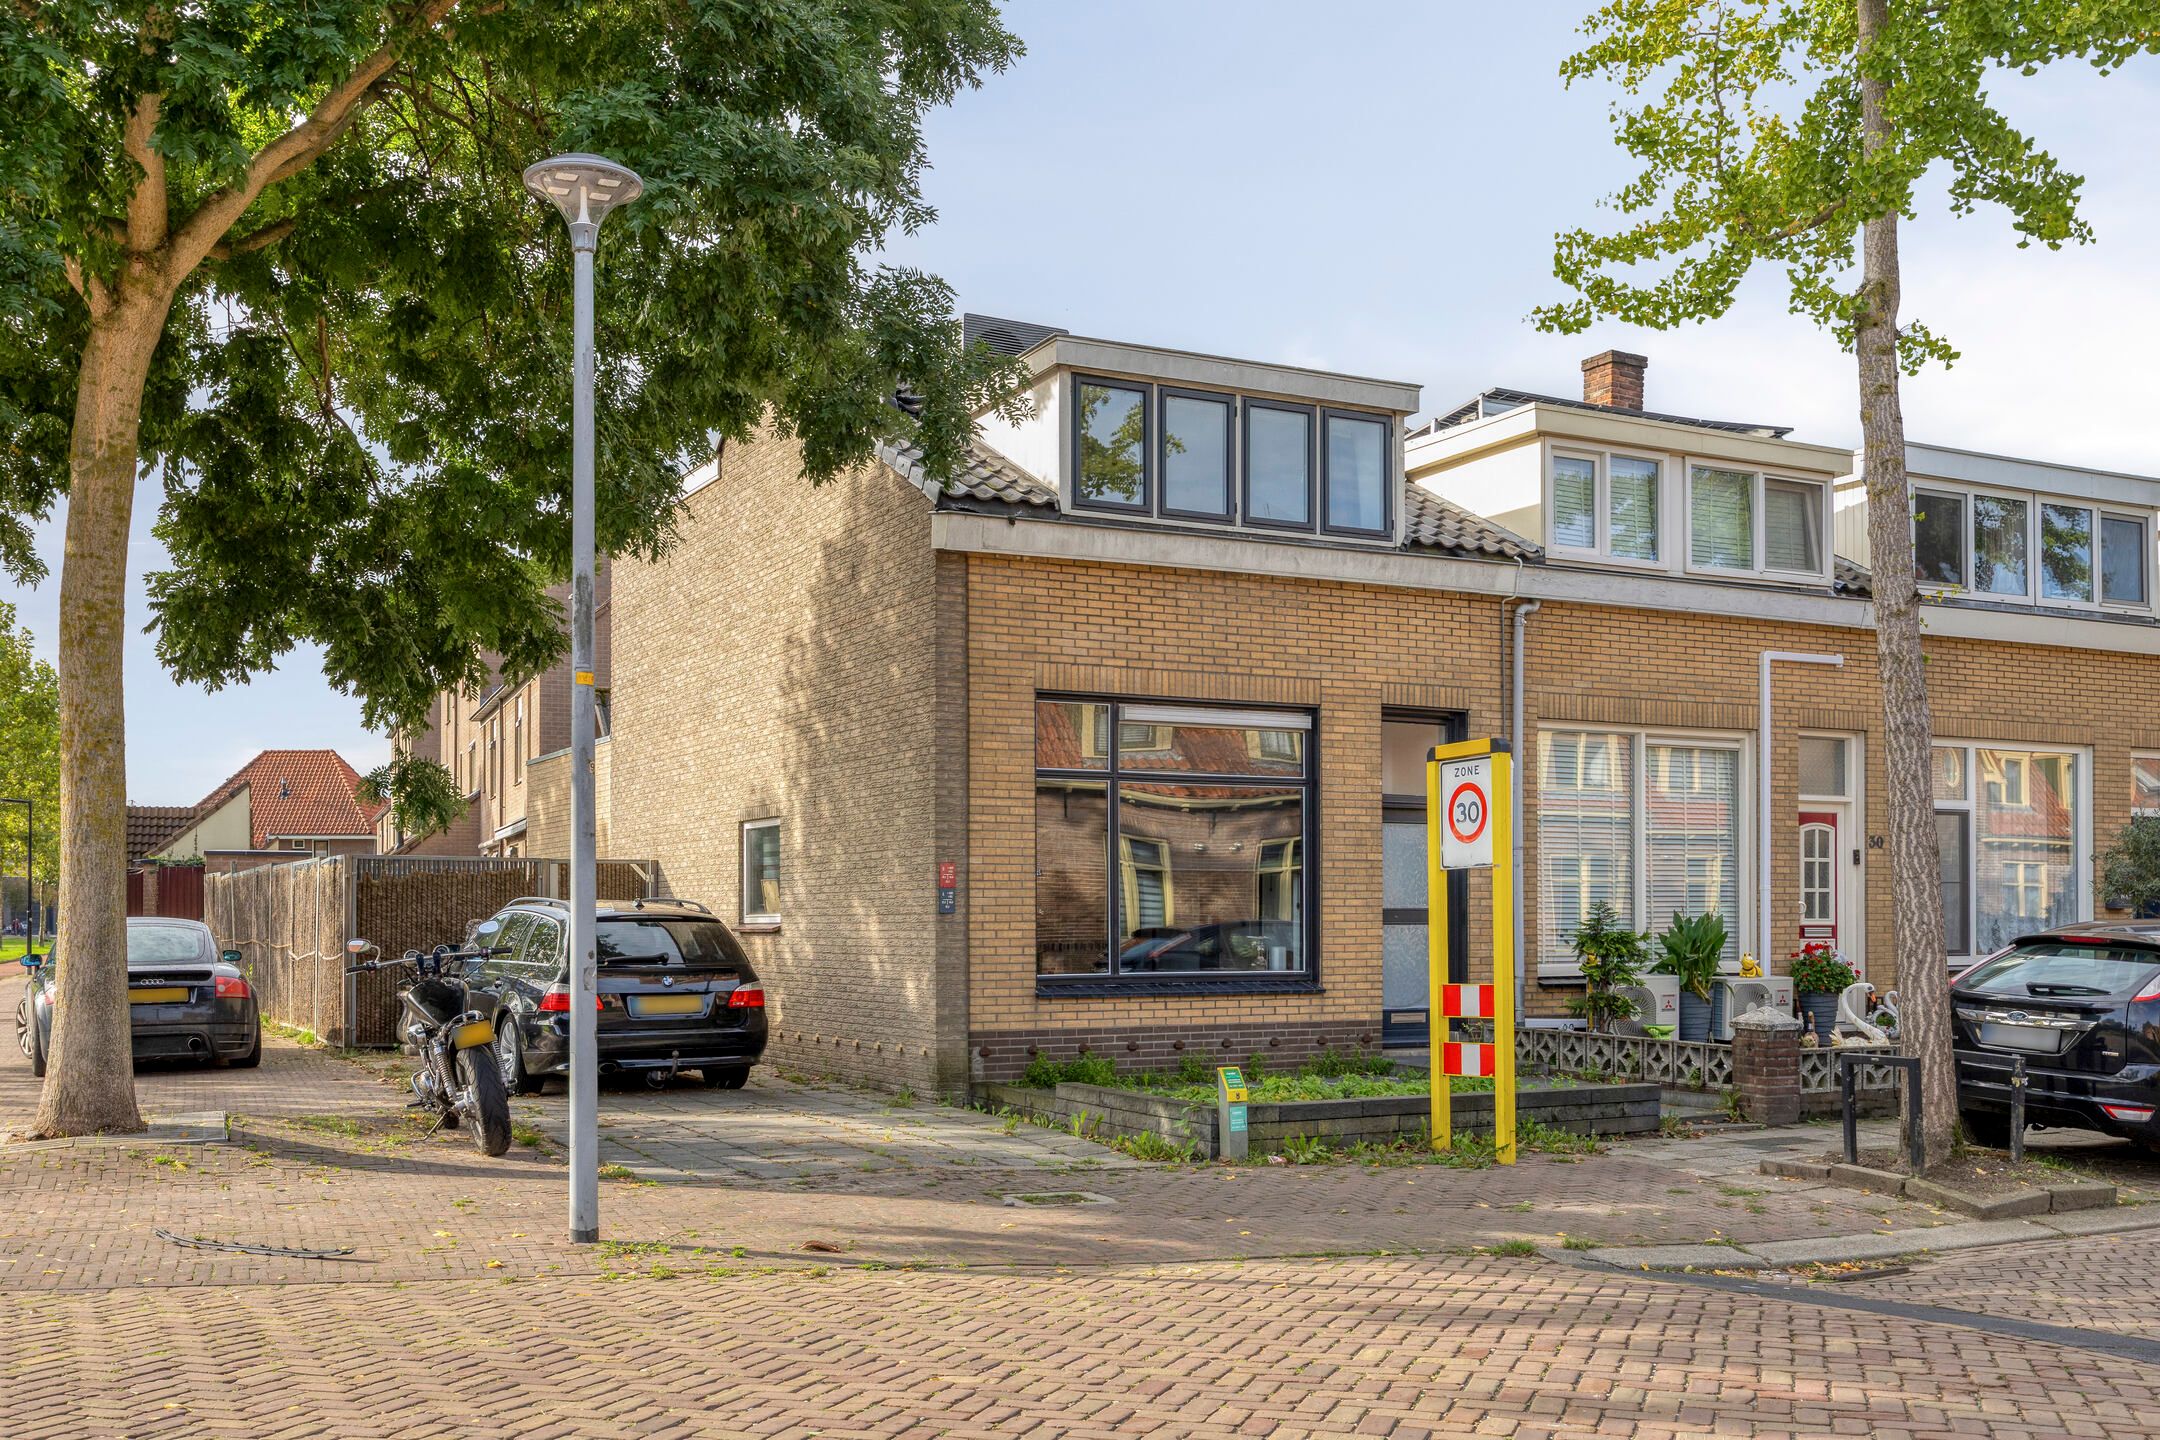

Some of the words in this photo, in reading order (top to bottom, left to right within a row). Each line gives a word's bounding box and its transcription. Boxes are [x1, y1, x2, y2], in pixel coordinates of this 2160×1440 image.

[1454, 765, 1480, 777] ZONE
[1456, 801, 1480, 823] 30
[1868, 835, 1884, 849] 30
